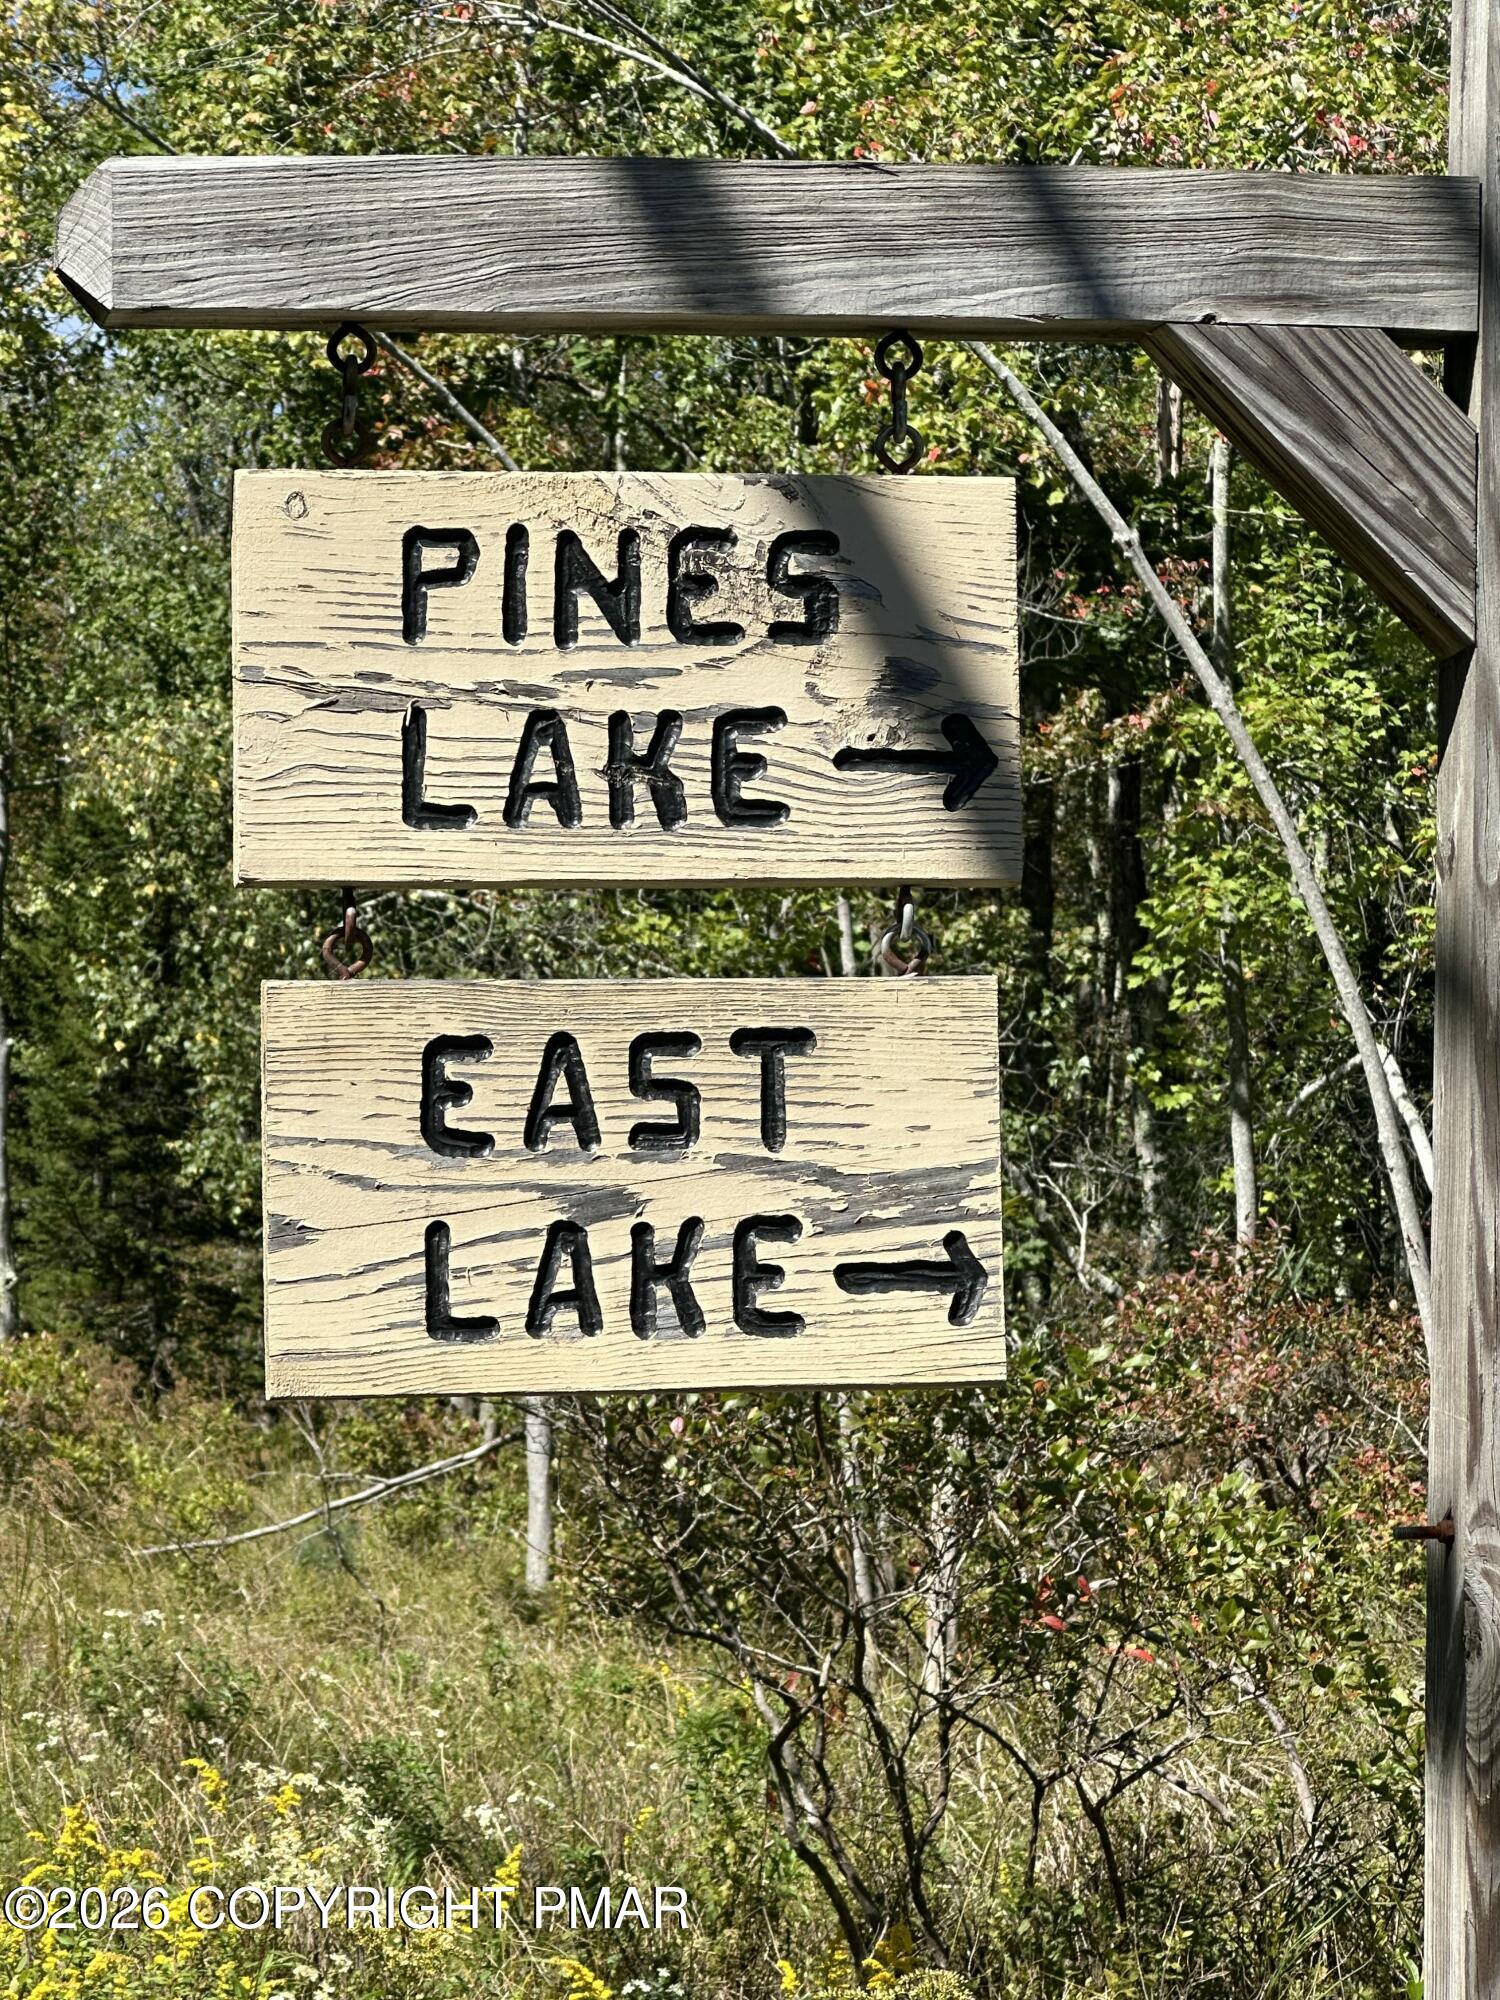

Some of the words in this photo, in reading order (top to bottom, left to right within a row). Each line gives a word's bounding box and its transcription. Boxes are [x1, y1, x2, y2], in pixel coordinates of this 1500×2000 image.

[402, 523, 840, 649] PINES
[402, 702, 791, 831] LAKE
[420, 1026, 817, 1158] EAST
[425, 1214, 806, 1341] LAKE
